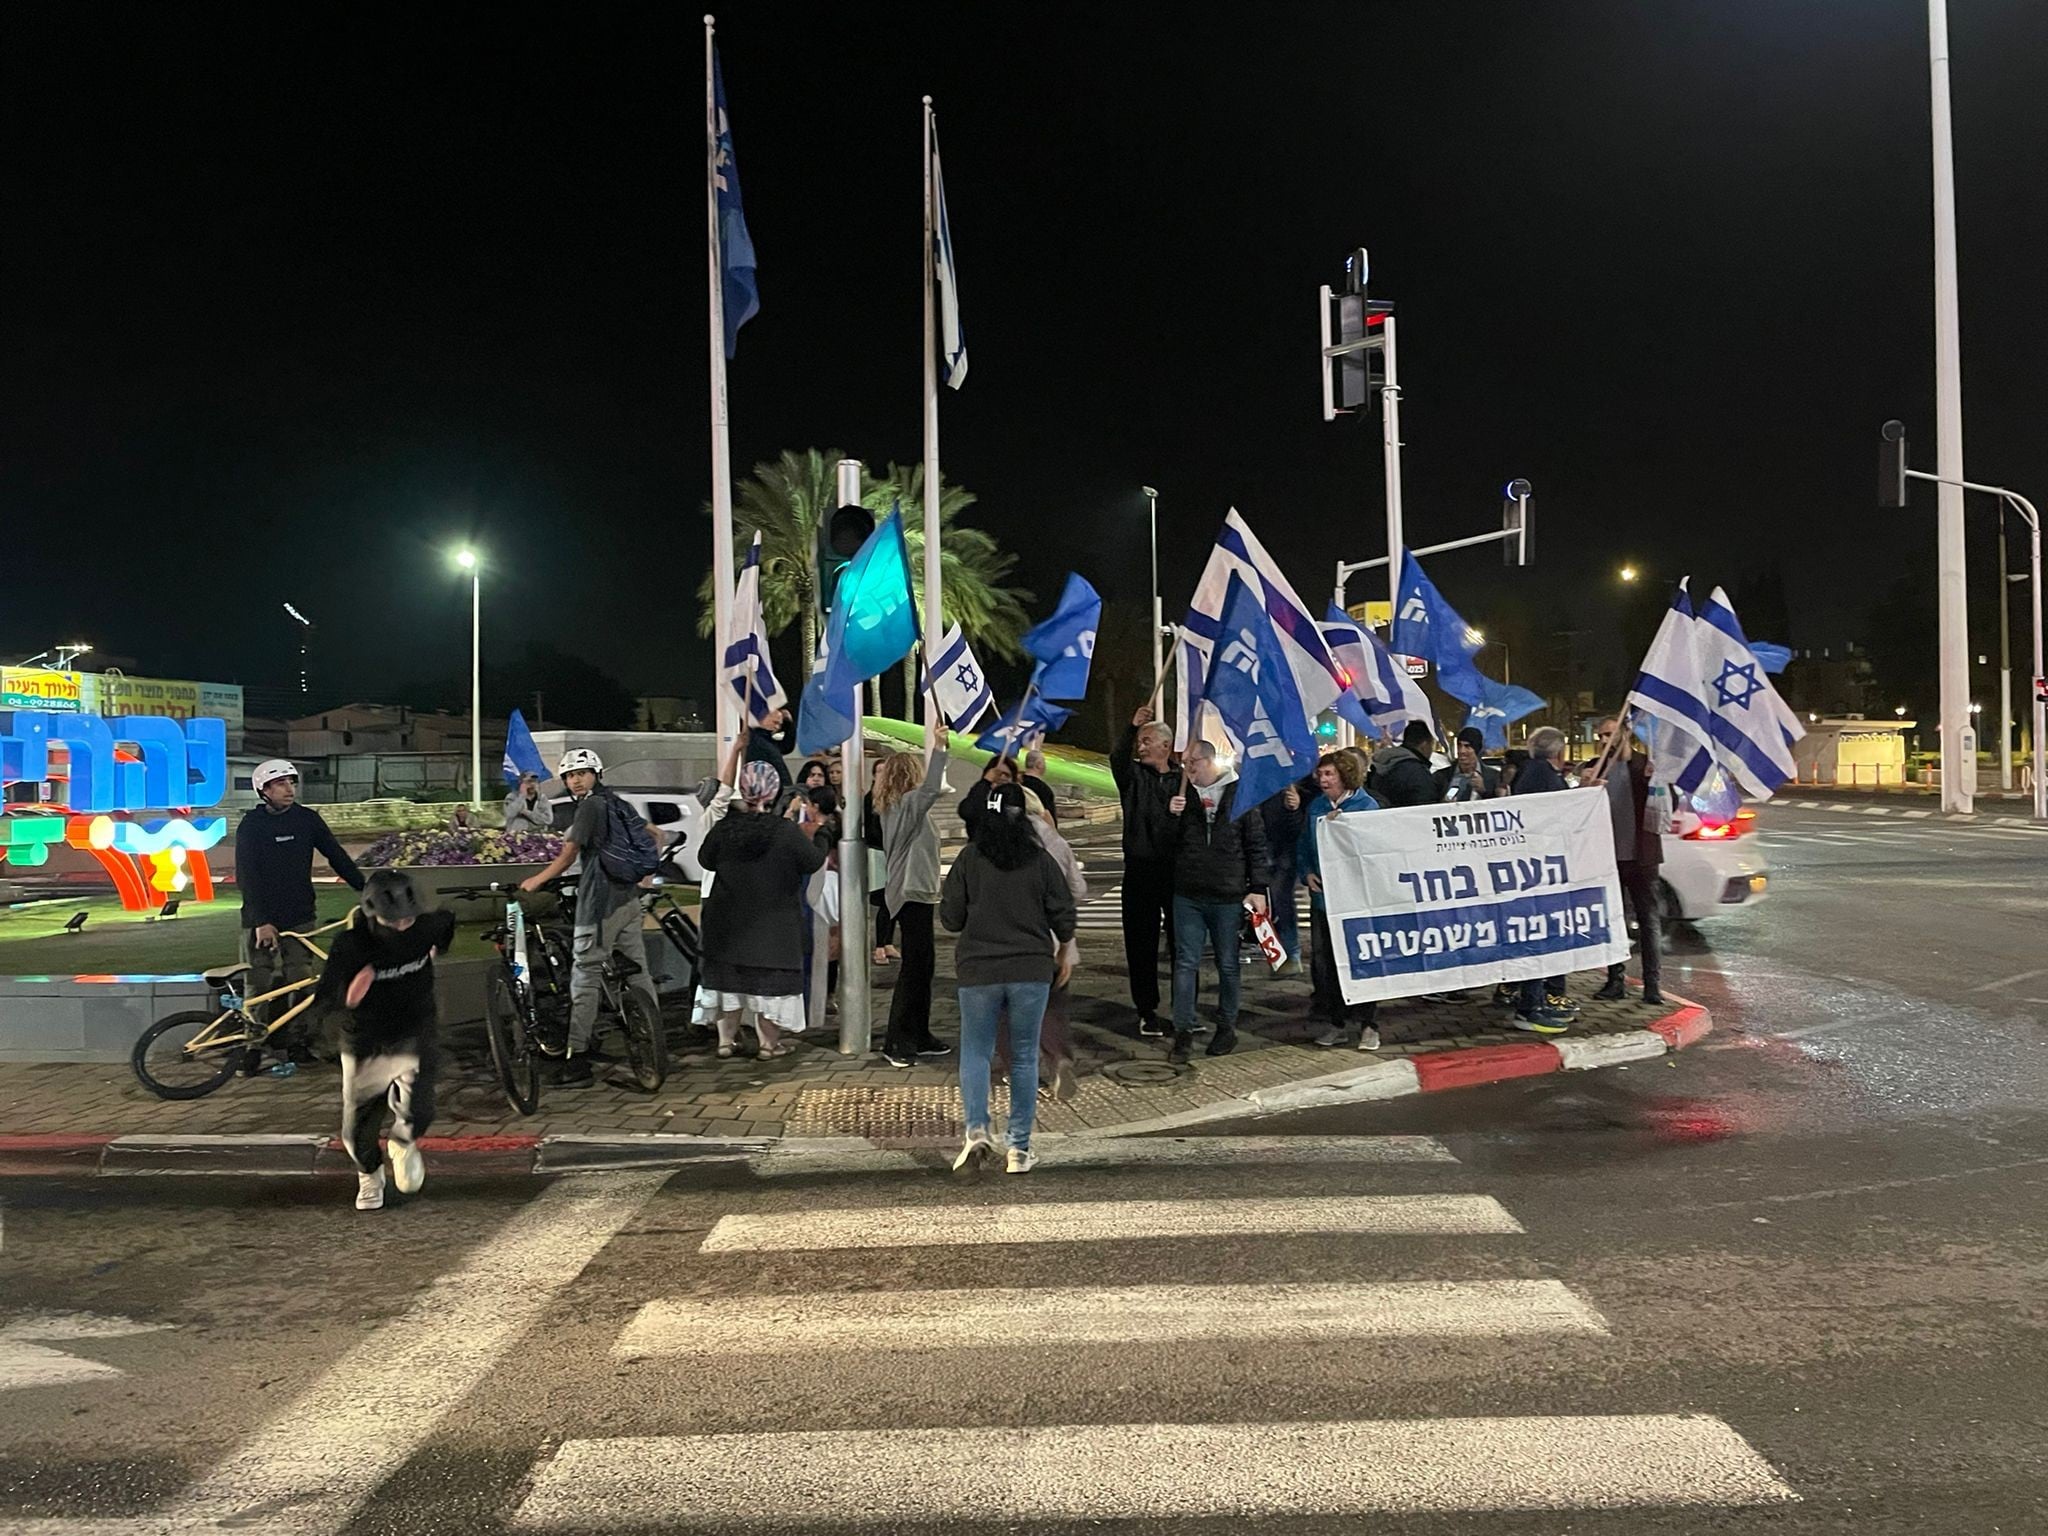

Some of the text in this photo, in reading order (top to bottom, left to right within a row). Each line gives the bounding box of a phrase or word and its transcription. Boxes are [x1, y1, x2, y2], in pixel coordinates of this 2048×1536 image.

[8, 680, 77, 699] תיווך העיר
[0, 710, 227, 816] נהרי
[1436, 834, 1527, 853] בונים חברה ציונית
[1398, 855, 1568, 903] העם בחר
[1357, 902, 1609, 961] רפורמה משפטית
